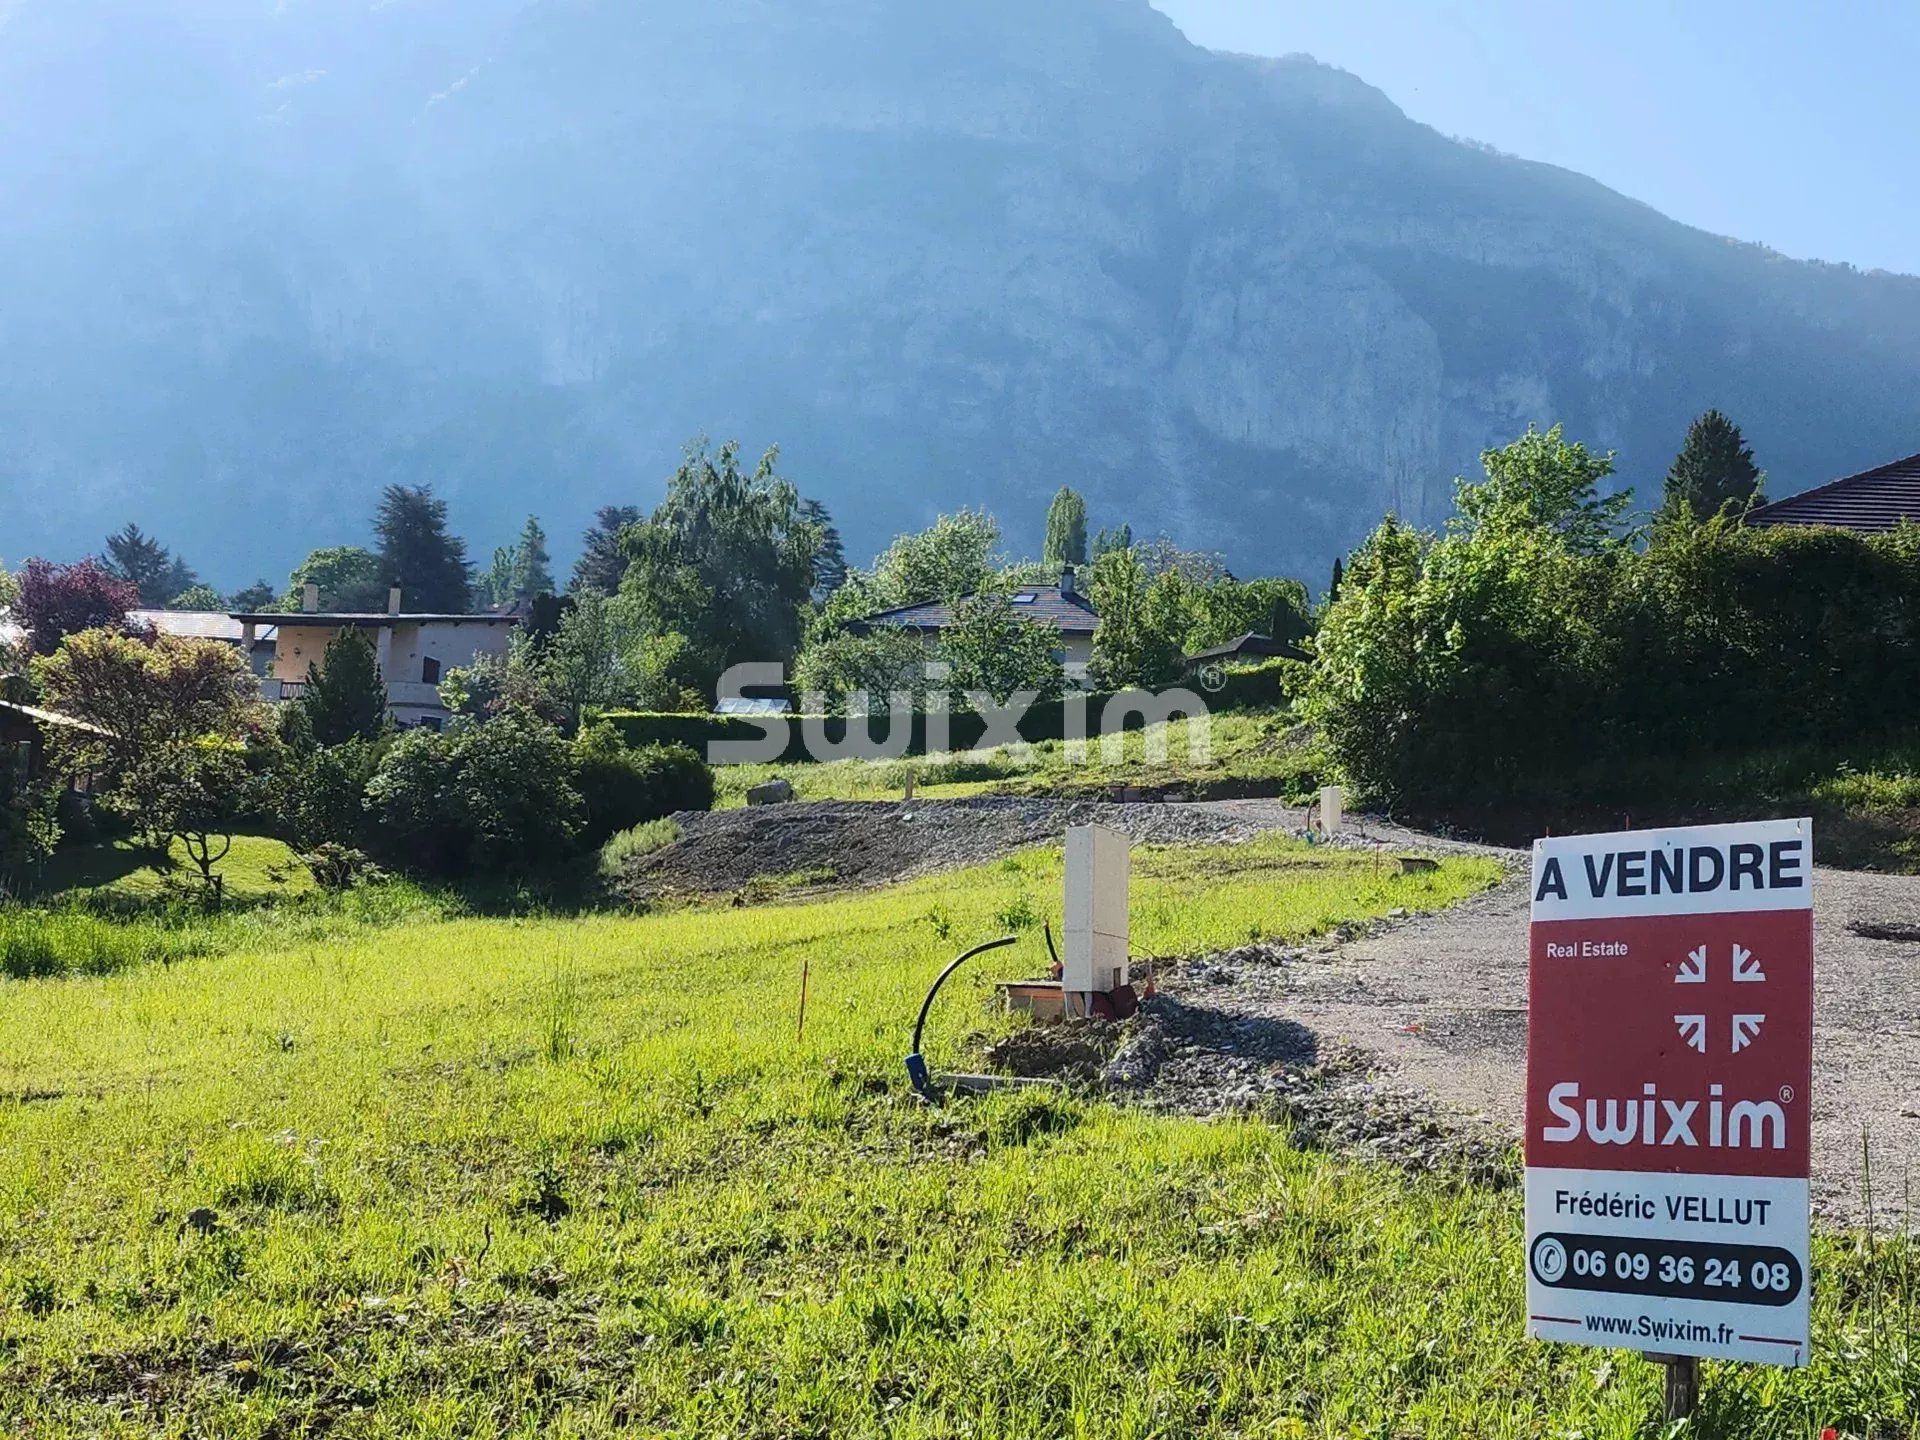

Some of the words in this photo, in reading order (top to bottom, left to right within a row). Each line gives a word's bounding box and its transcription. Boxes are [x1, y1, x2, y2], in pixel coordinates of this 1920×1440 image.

[1535, 857, 1568, 901] A
[1583, 840, 1803, 898] VENDRE
[1547, 942, 1577, 957] Real
[1582, 941, 1628, 957] Estate
[1543, 1082, 1786, 1149] Swixim
[1556, 1190, 1656, 1219] Frédéric
[1665, 1196, 1771, 1226] VELLUT
[1573, 1249, 1606, 1277] 06
[1615, 1253, 1650, 1281] 09
[1659, 1255, 1695, 1285] 36
[1704, 1258, 1741, 1288] 24
[1751, 1261, 1790, 1292] 08
[1586, 1315, 1734, 1344] www.Swixim.fr
